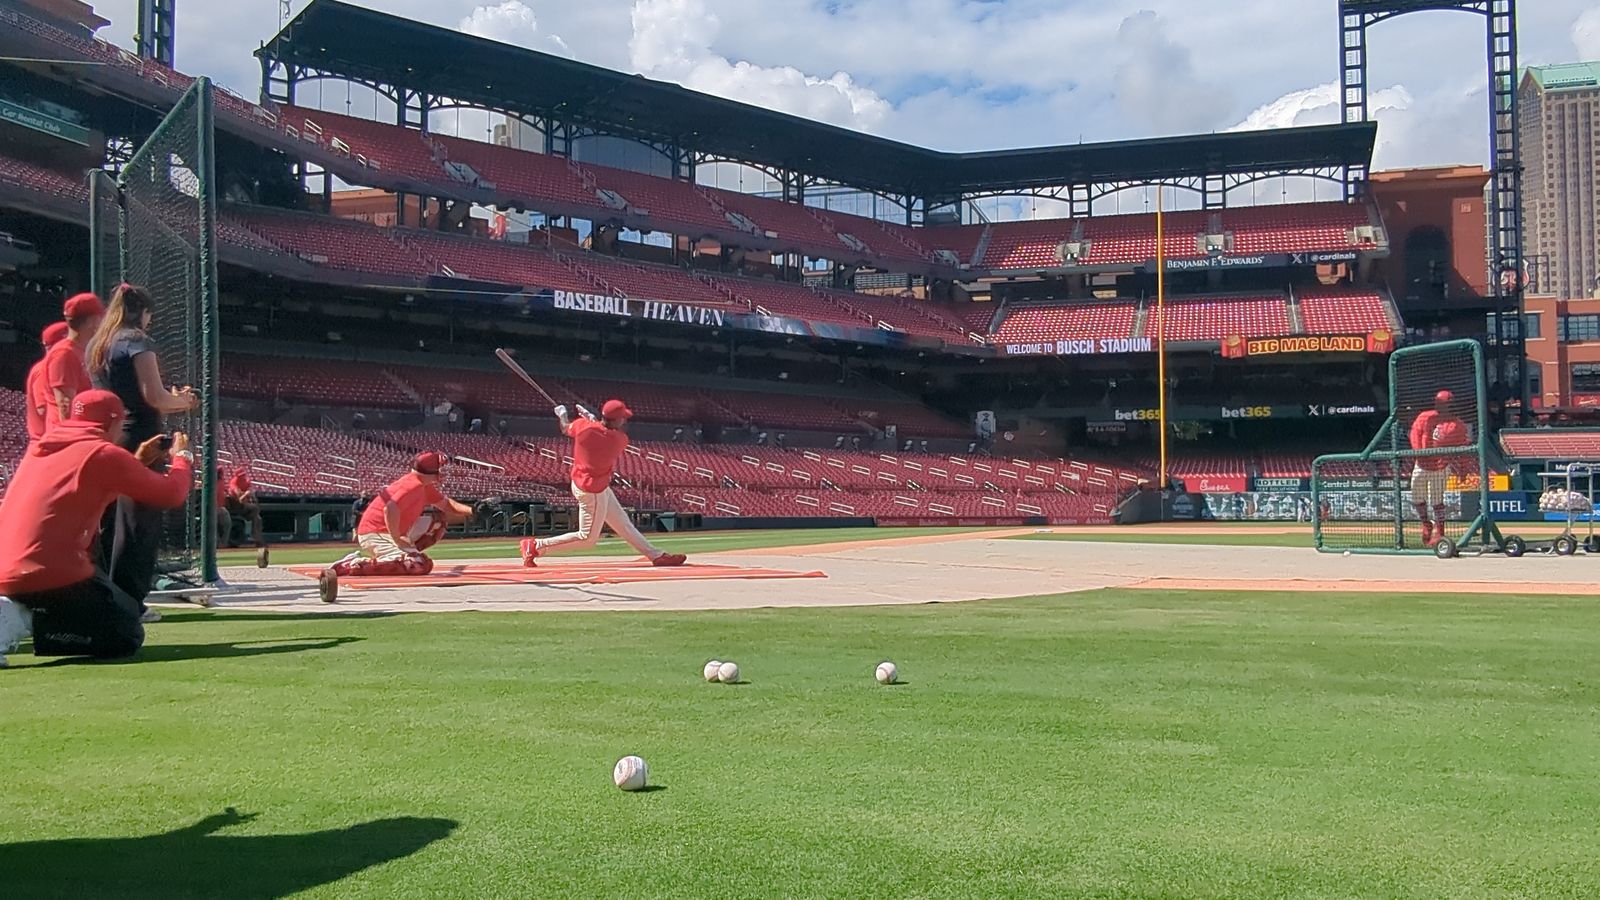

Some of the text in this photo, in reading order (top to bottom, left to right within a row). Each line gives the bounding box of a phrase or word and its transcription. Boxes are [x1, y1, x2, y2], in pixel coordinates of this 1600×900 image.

[43, 122, 61, 133] Club
[1311, 252, 1356, 262] @cardinals
[1166, 259, 1210, 268] BENJAMIN
[553, 289, 726, 327] BASEBALL HEAVEN
[1006, 337, 1152, 355] WELCOME TO BUSCH STADIUM
[1248, 336, 1365, 355] BIG MAC LAND
[1115, 409, 1161, 421] bet365
[1222, 406, 1272, 418] bet365
[1328, 405, 1375, 415] @cardinals
[1322, 480, 1350, 488] Central
[1488, 500, 1526, 513] TIFEL
